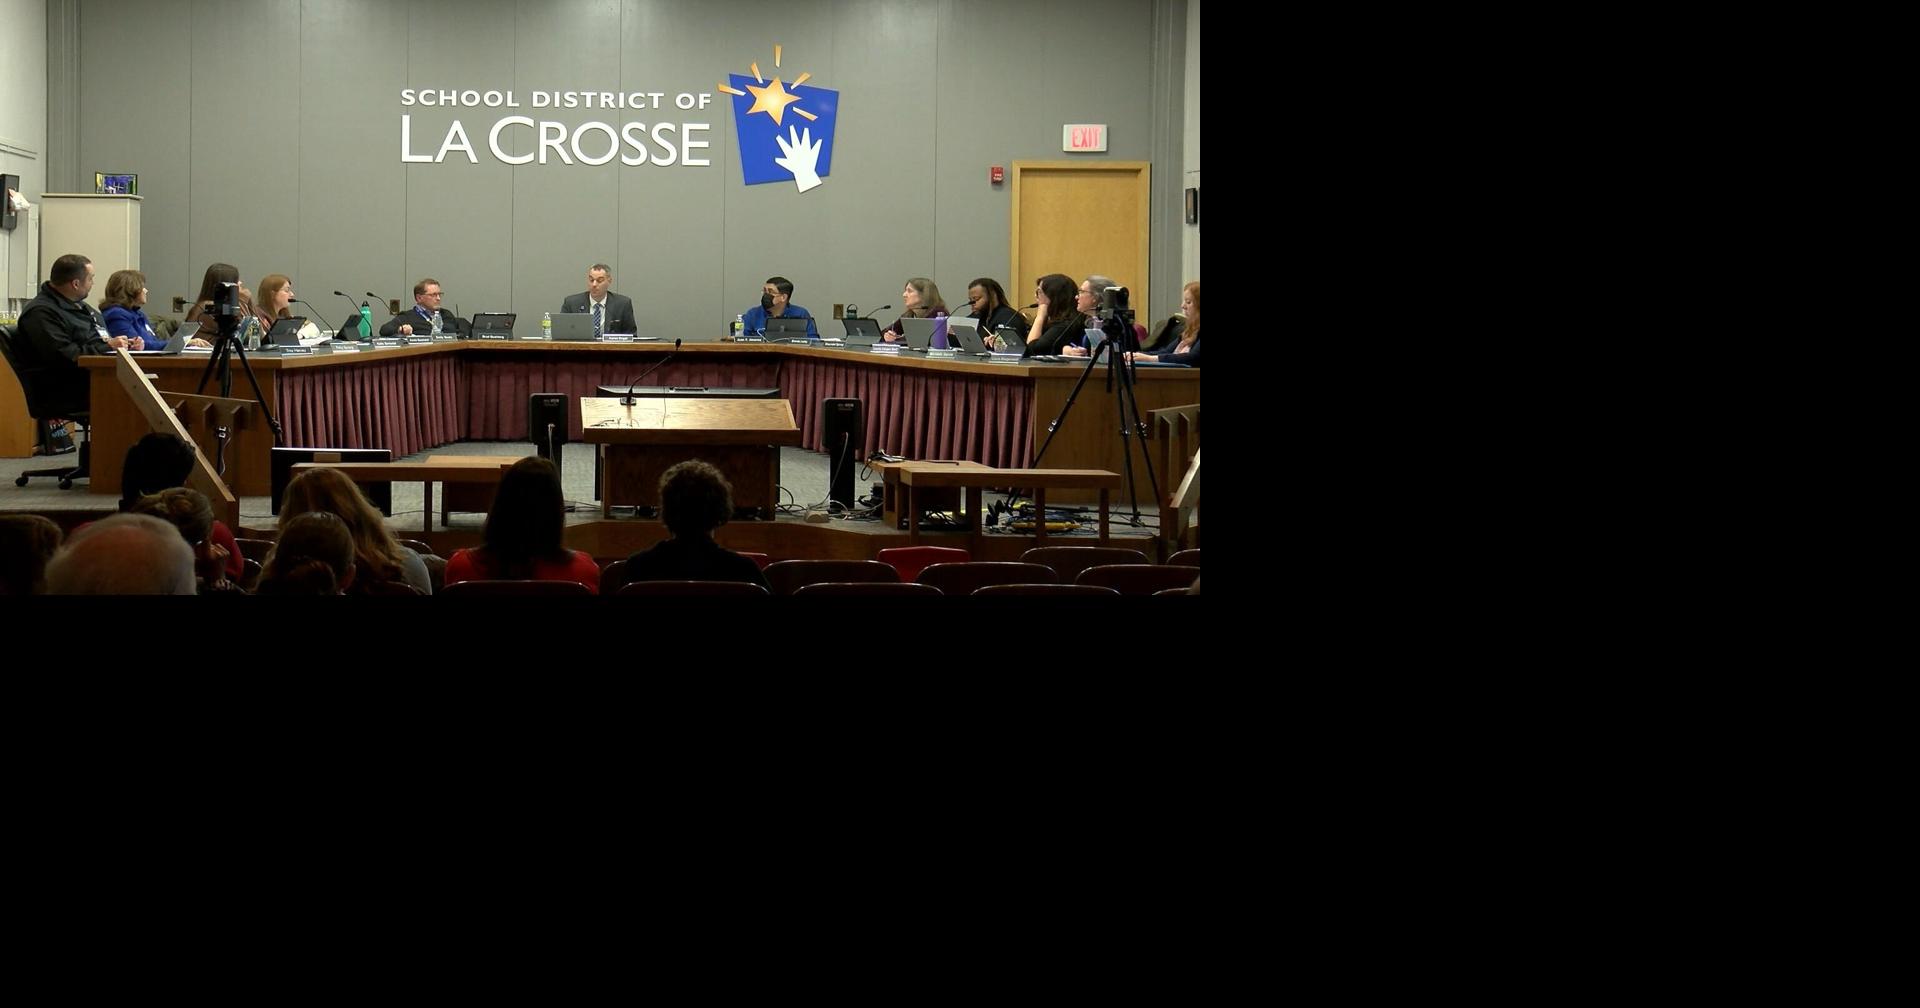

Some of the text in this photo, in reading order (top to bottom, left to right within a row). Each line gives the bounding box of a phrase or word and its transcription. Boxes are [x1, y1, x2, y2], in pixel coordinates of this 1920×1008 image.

[400, 89, 712, 110] SCHOOL DISTRICT OF
[400, 114, 712, 167] LA CROSSE
[1072, 127, 1102, 148] EXIT
